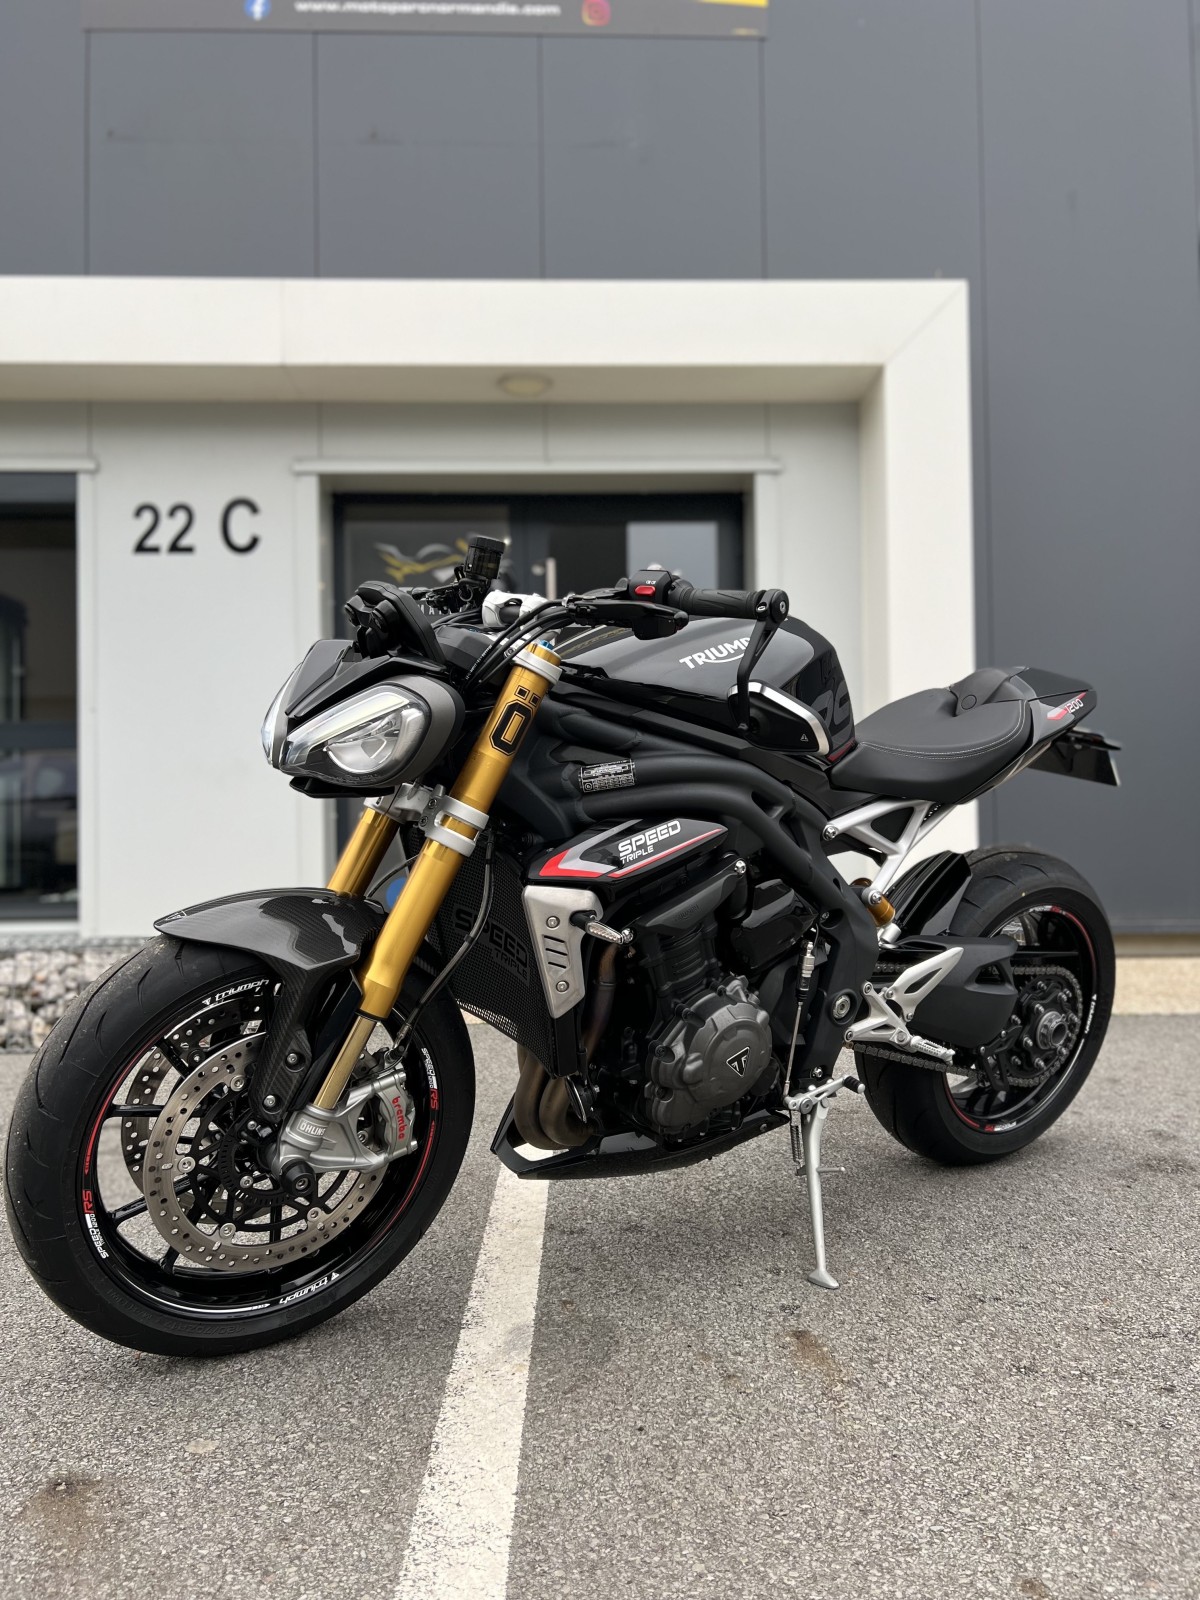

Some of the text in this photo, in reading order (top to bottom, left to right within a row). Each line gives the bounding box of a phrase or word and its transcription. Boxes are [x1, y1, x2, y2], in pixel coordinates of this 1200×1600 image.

[133, 497, 260, 556] 22 C
[1065, 698, 1084, 714] 1200
[618, 820, 681, 857] SPEED
[620, 845, 655, 864] TRIPLE
[392, 1096, 407, 1140] brembo
[82, 1190, 95, 1214] RS
[89, 1228, 109, 1259] SPEED
